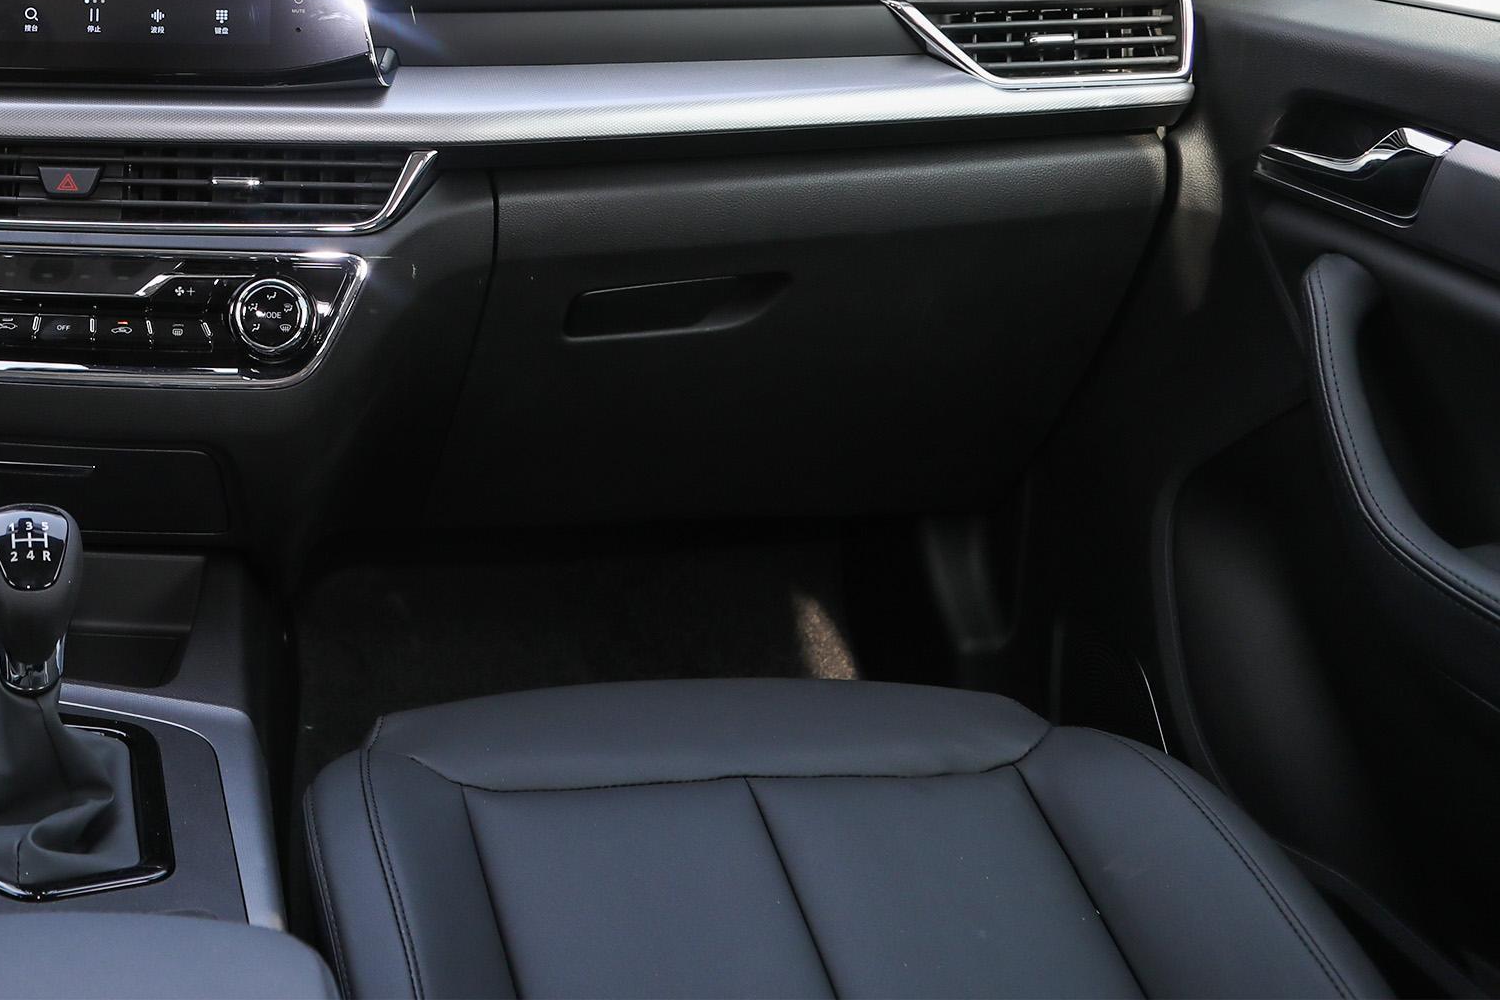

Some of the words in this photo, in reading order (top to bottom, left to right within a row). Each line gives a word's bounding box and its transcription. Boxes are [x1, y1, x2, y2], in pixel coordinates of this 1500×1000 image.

[87, 25, 101, 33] 停止
[56, 324, 71, 332] OFF
[9, 522, 15, 531] 1
[25, 521, 33, 531] 3
[41, 521, 49, 531] 5
[10, 551, 19, 562] 2
[26, 550, 35, 560] 4
[42, 550, 51, 561] R
